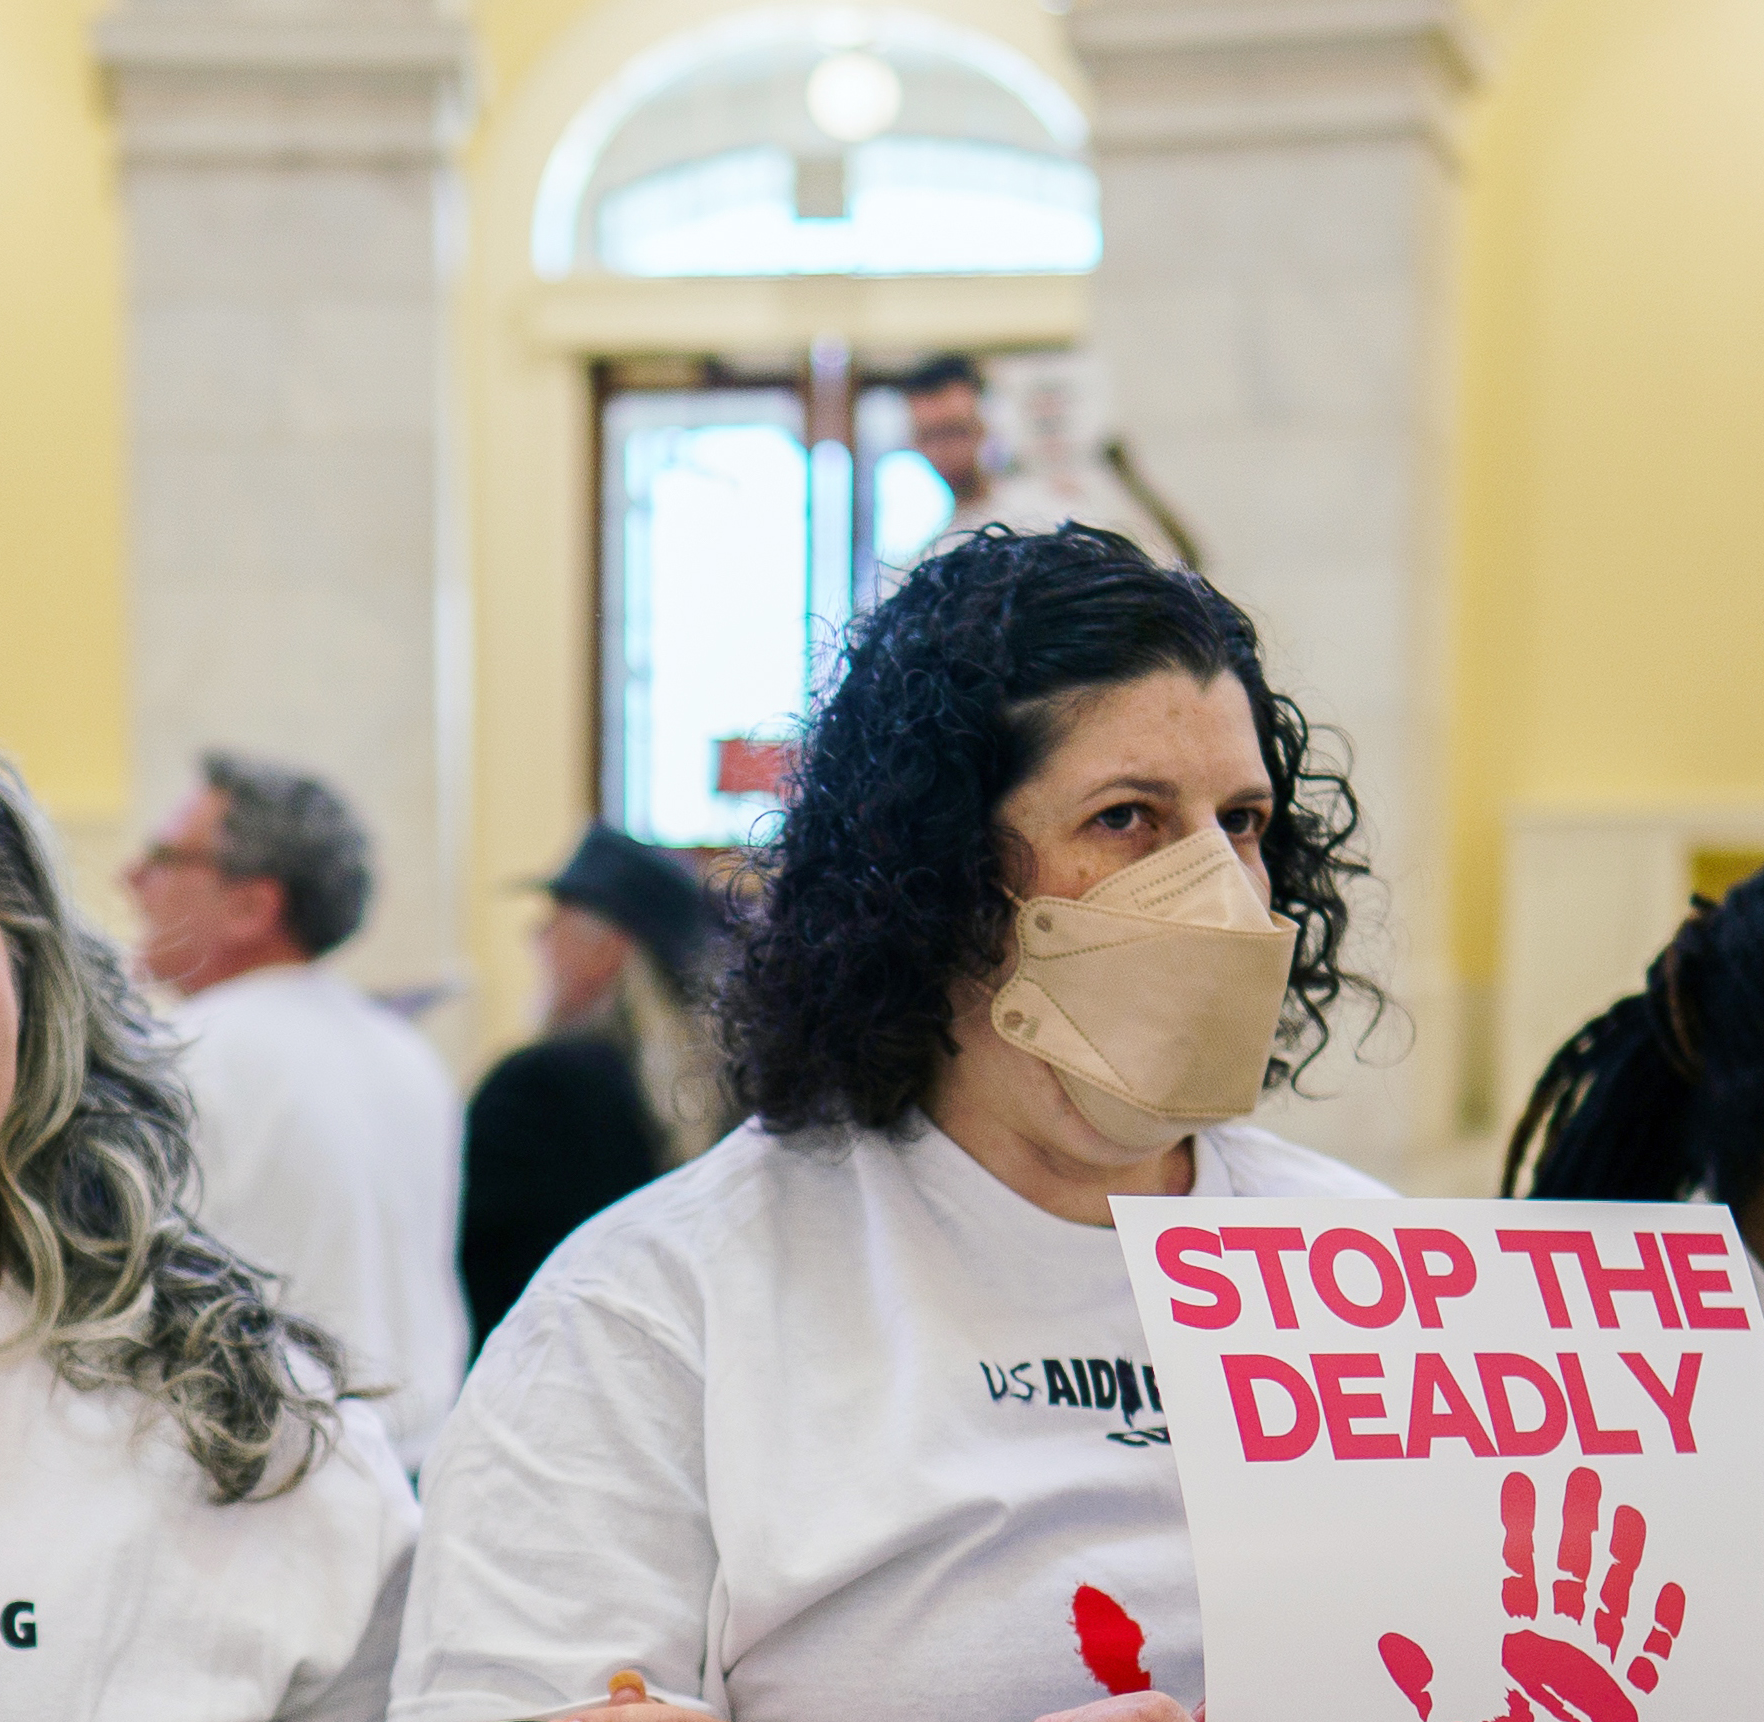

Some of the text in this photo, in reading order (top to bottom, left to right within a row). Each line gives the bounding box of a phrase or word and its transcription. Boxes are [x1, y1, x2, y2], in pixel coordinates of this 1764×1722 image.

[1155, 1226, 1750, 1331] STOP THE
[1220, 1352, 1703, 1462] DEADLY
